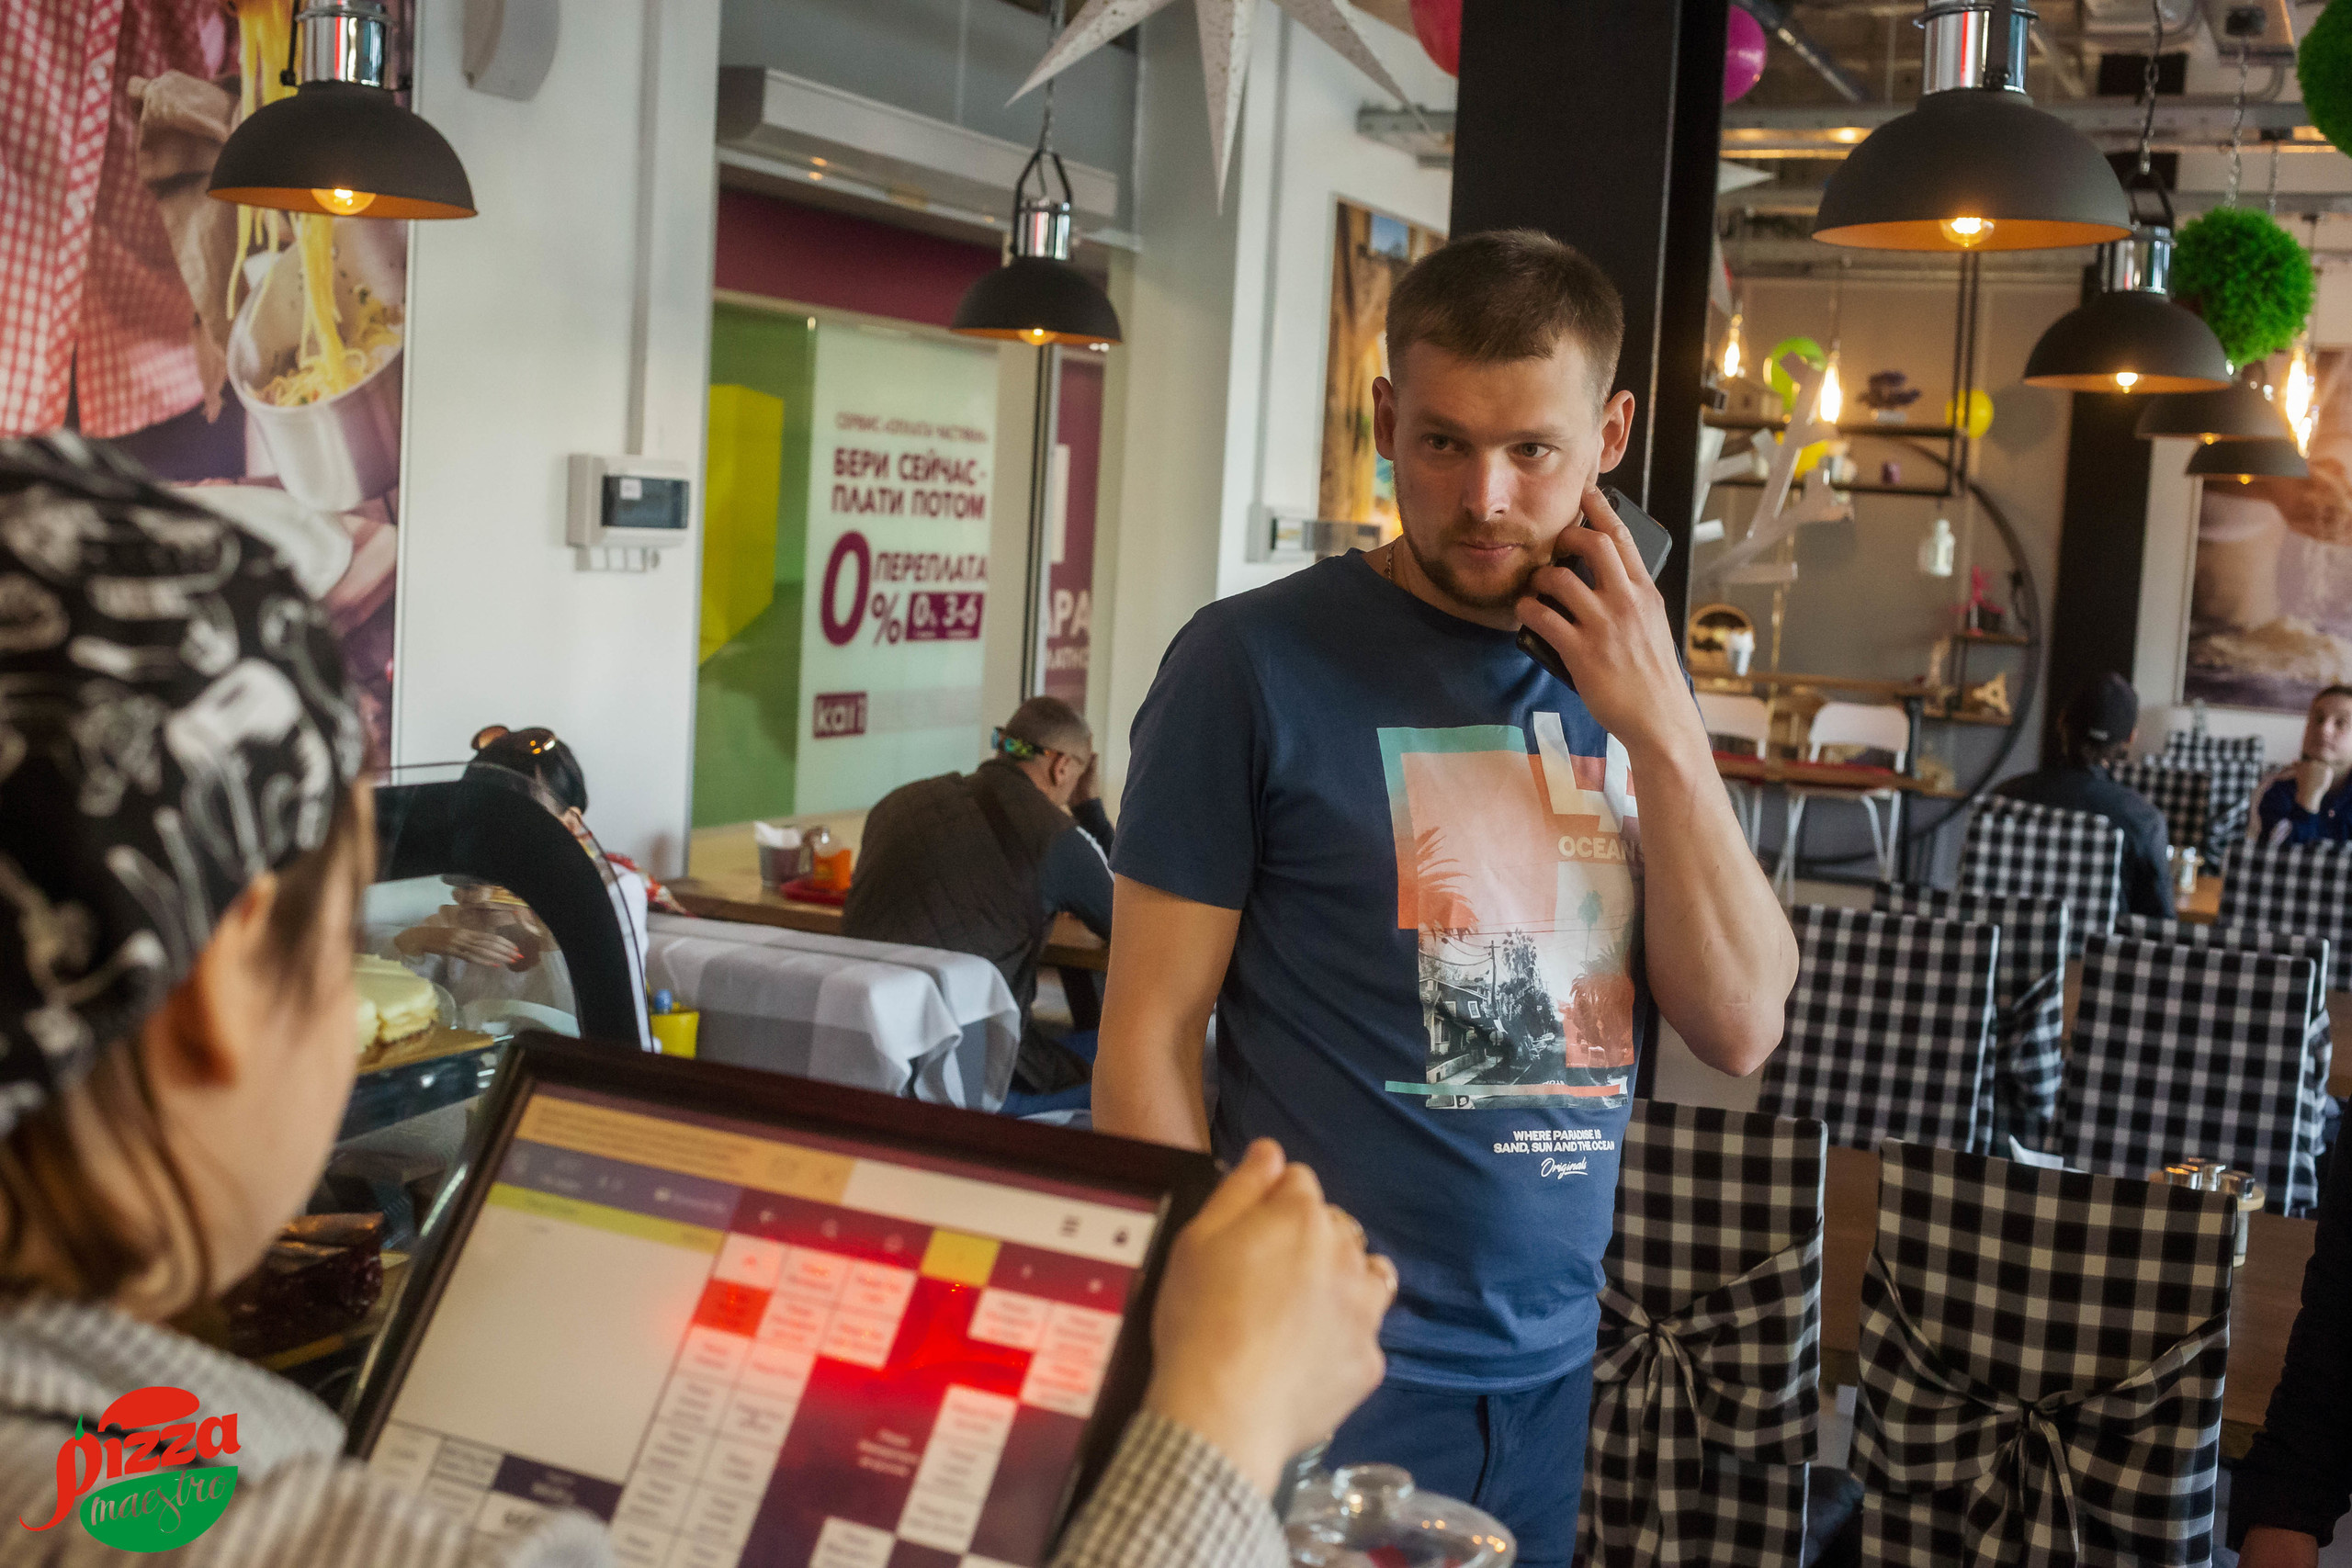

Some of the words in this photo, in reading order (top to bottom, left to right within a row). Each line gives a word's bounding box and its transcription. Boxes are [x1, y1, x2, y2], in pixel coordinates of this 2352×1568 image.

[833, 446, 890, 479] БЕРИ
[831, 484, 905, 514] ПЛАТИ
[910, 489, 986, 520] ПОТОМ
[873, 553, 989, 583] ПЕРЕПЛАТА
[1493, 1142, 1531, 1155] SAND,
[1531, 1142, 1553, 1153] SUN
[1554, 1141, 1578, 1153] AND
[1577, 1141, 1592, 1151] THE
[1591, 1140, 1615, 1151] OCEAN
[1512, 1130, 1552, 1142] WHERE
[1552, 1129, 1594, 1141] PARADISE
[1594, 1129, 1602, 1140] IS
[1540, 1156, 1589, 1180] Originals
